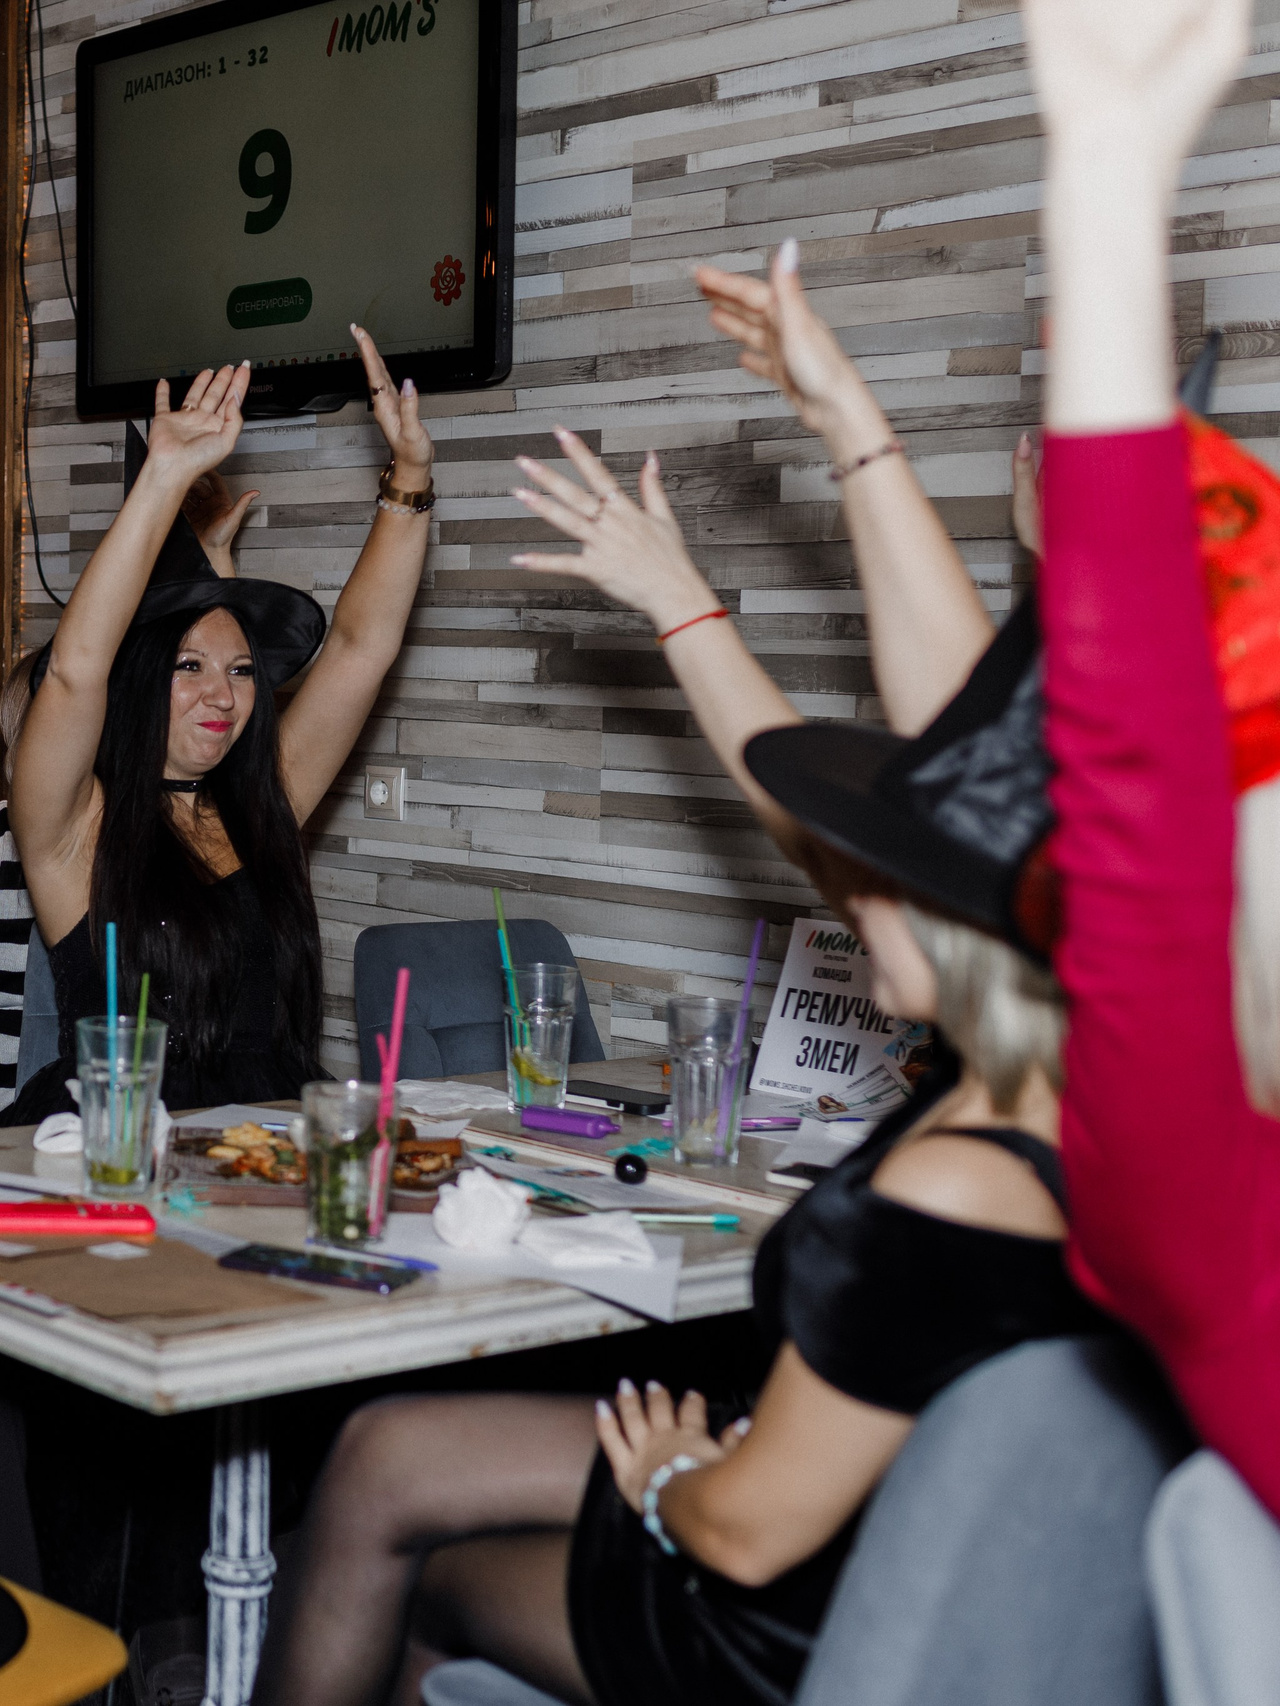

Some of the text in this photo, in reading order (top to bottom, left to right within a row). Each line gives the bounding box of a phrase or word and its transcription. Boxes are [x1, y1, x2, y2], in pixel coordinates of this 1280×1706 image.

[123, 61, 212, 103] ДИАПАЗОН:
[218, 56, 227, 75] 1
[247, 46, 269, 68] 32
[238, 128, 293, 235] 9
[234, 294, 305, 313] СГЕНЕРИРОВАТЬ
[249, 384, 274, 394] PHILIPS
[812, 966, 853, 983] КОМАНДА
[780, 987, 895, 1035] ГРЕМУЧИЕ
[795, 1036, 861, 1076] ЗМЕИ
